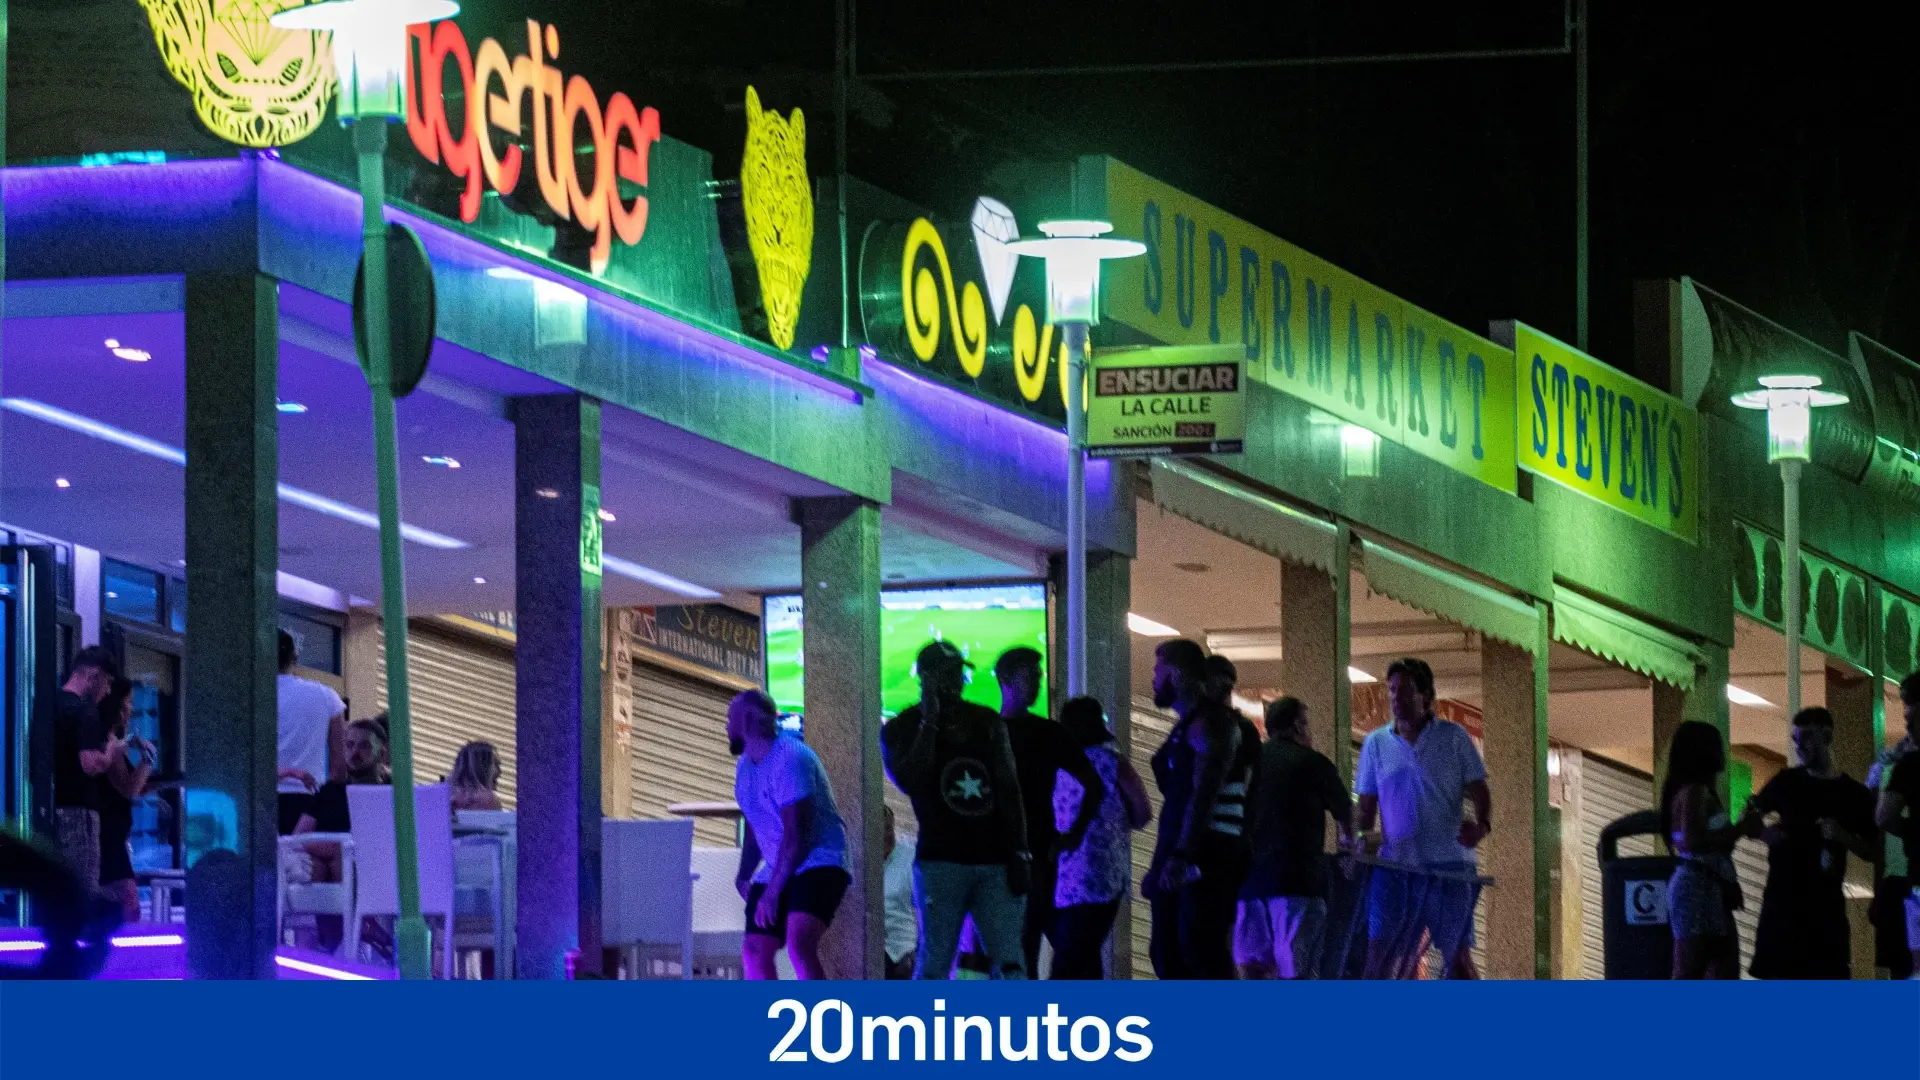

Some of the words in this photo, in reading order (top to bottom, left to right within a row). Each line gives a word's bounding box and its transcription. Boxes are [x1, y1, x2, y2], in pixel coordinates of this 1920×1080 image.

[1143, 200, 1486, 461] SUPERMARKET
[1099, 366, 1234, 394] ENSUCIAR
[1121, 399, 1145, 416] LA
[1150, 396, 1212, 415] CALLE
[1113, 423, 1172, 439] SANCIÓN
[1531, 353, 1684, 519] STEVEN'S
